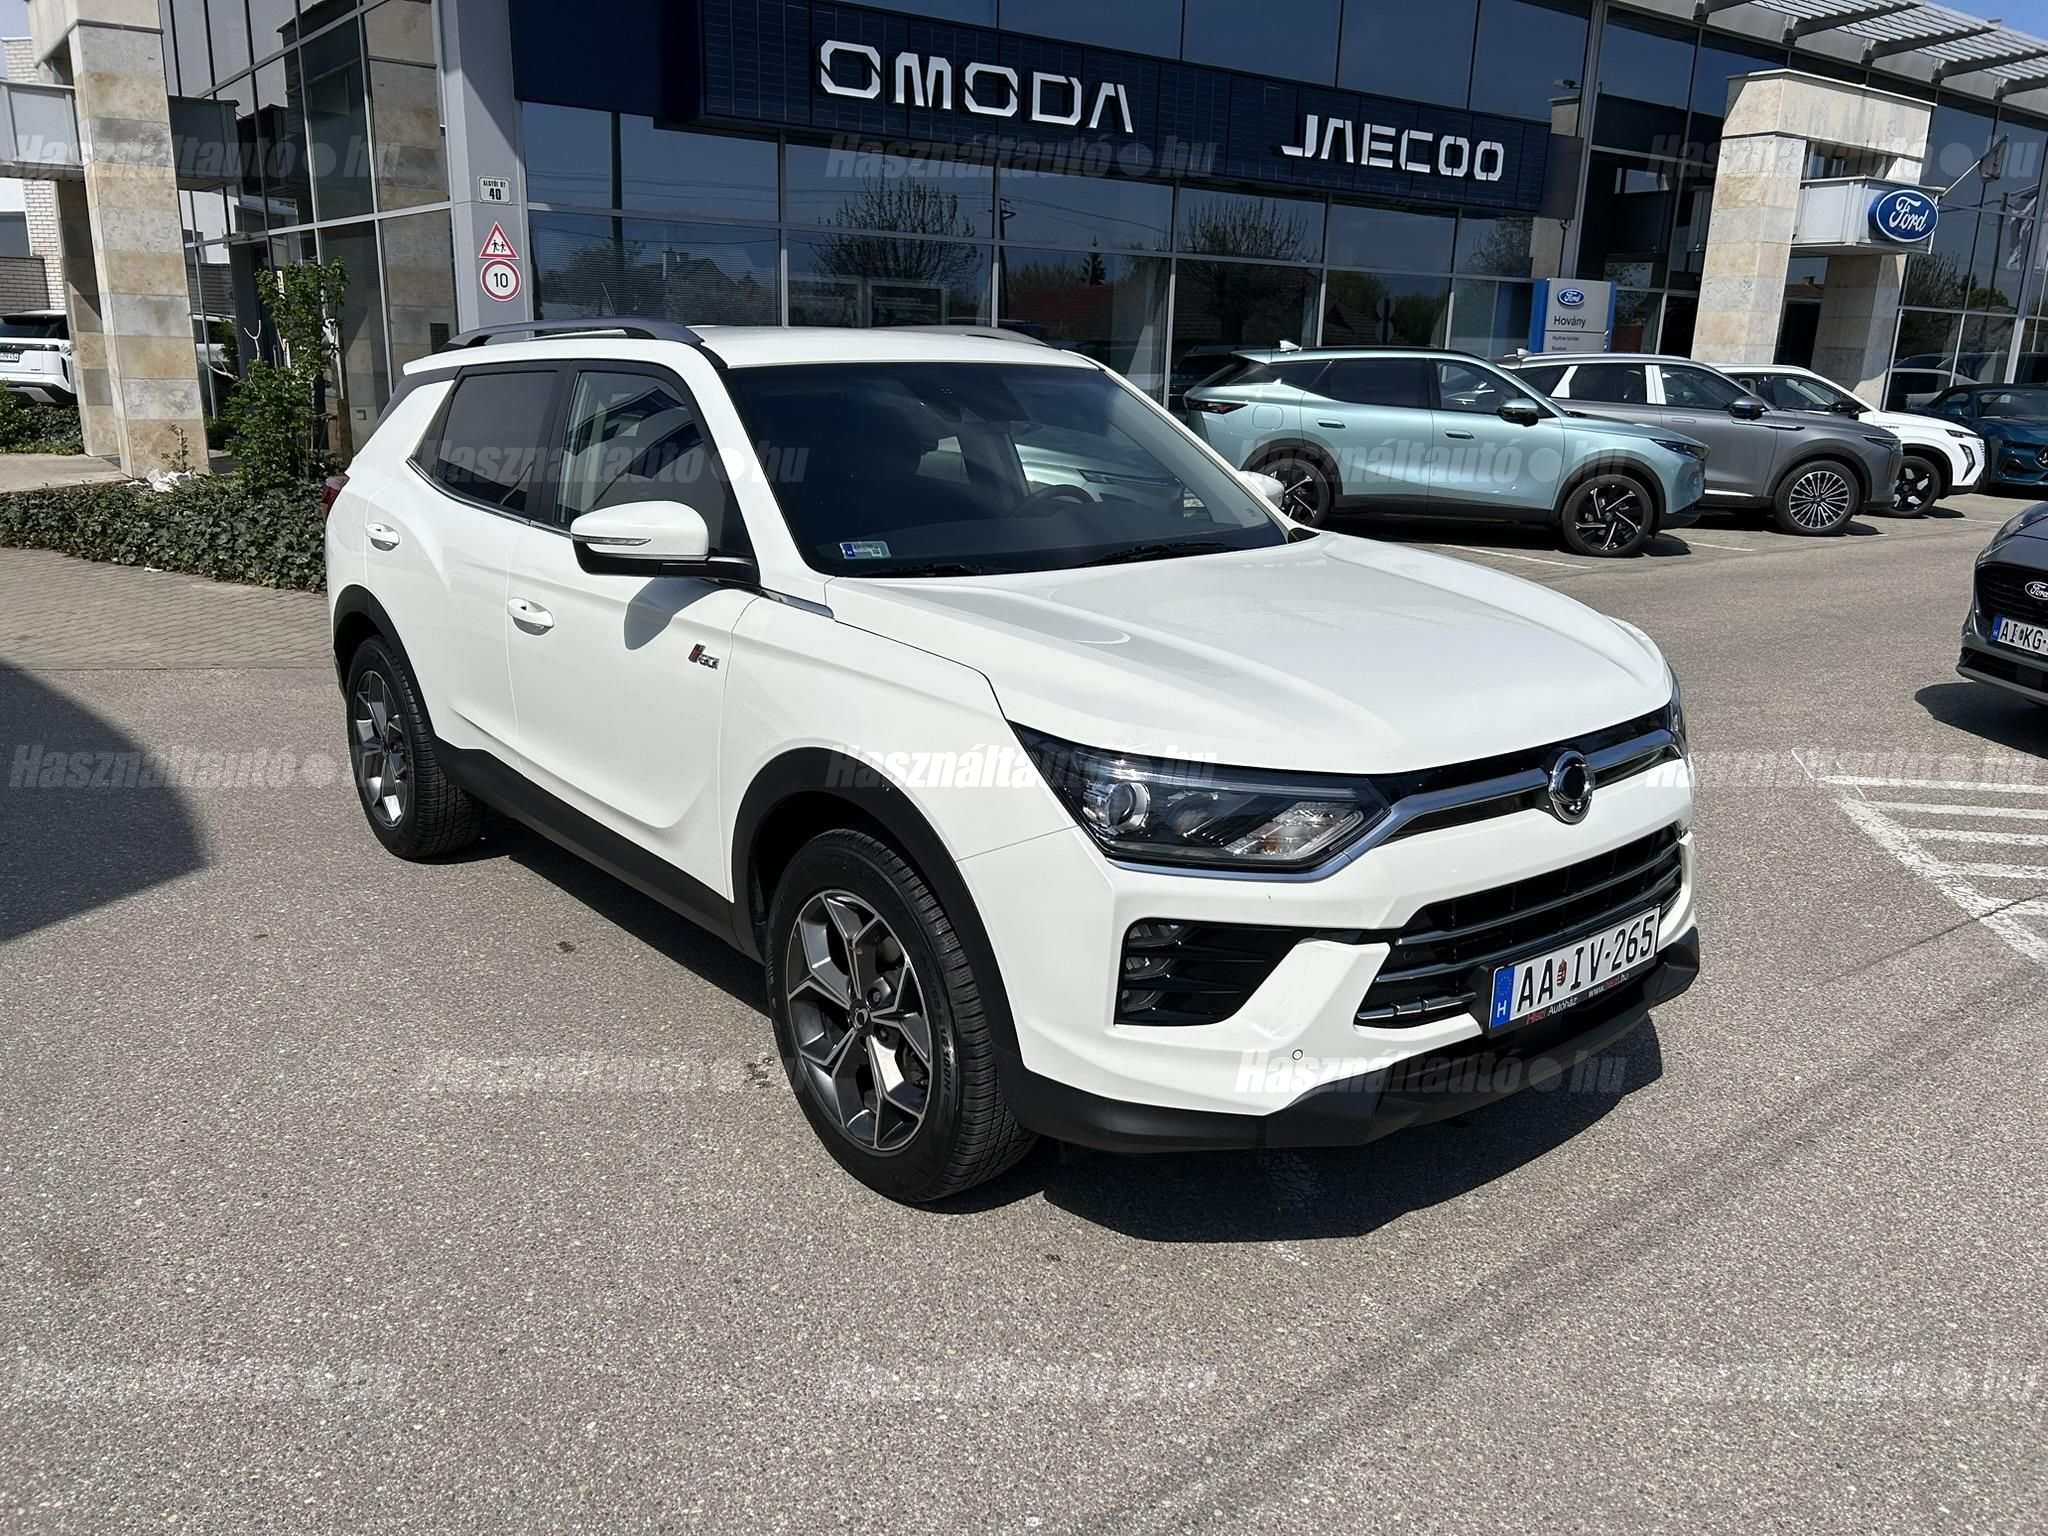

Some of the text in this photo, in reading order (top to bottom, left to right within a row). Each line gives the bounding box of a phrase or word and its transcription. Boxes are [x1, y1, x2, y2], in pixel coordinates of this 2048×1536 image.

[819, 39, 1134, 133] OMODA
[1280, 114, 1505, 182] JAECOO
[489, 187, 502, 200] 40
[1889, 196, 1929, 232] Ford
[493, 272, 509, 288] 10
[1553, 315, 1587, 329] Hovány
[1496, 1000, 1508, 1018] H
